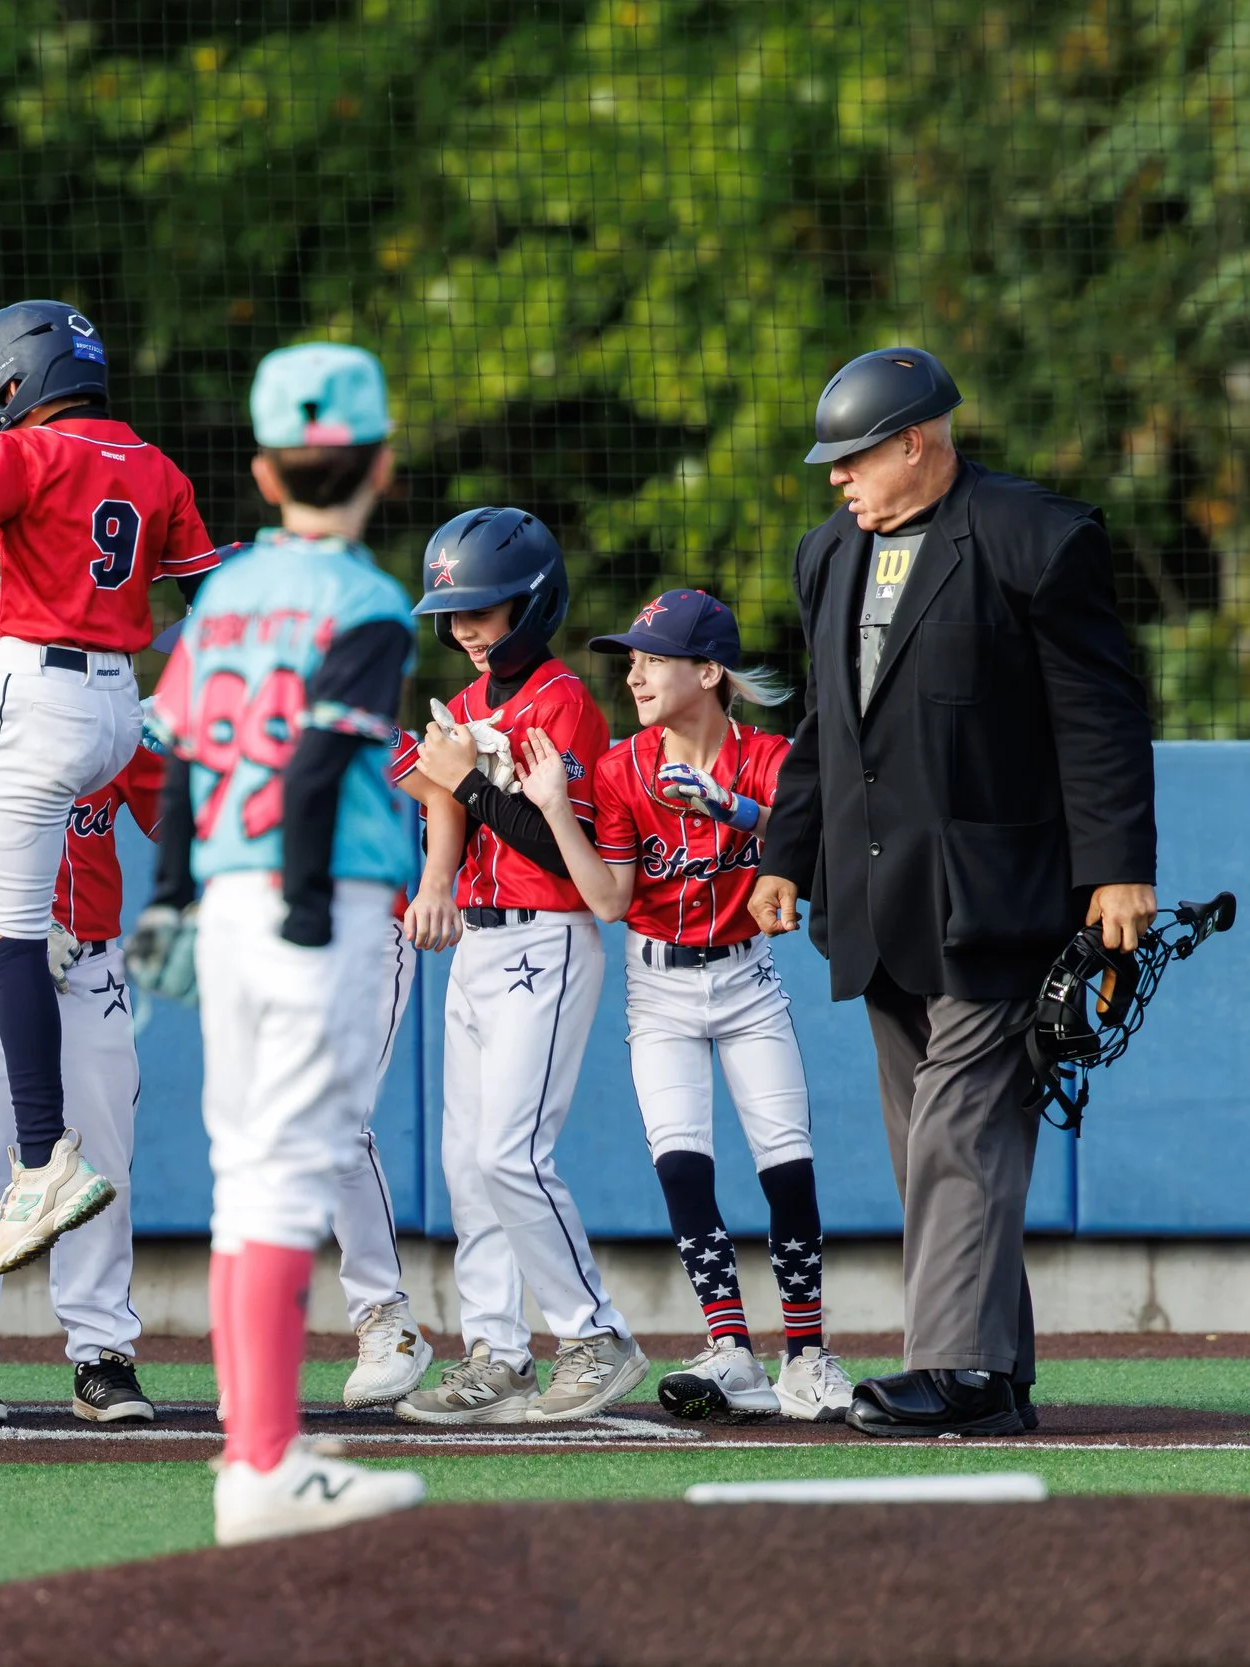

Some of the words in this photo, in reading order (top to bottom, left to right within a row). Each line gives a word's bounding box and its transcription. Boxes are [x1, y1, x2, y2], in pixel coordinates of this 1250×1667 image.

[101, 450, 126, 462] marucci
[89, 499, 142, 591] 9
[96, 667, 120, 677] marucci
